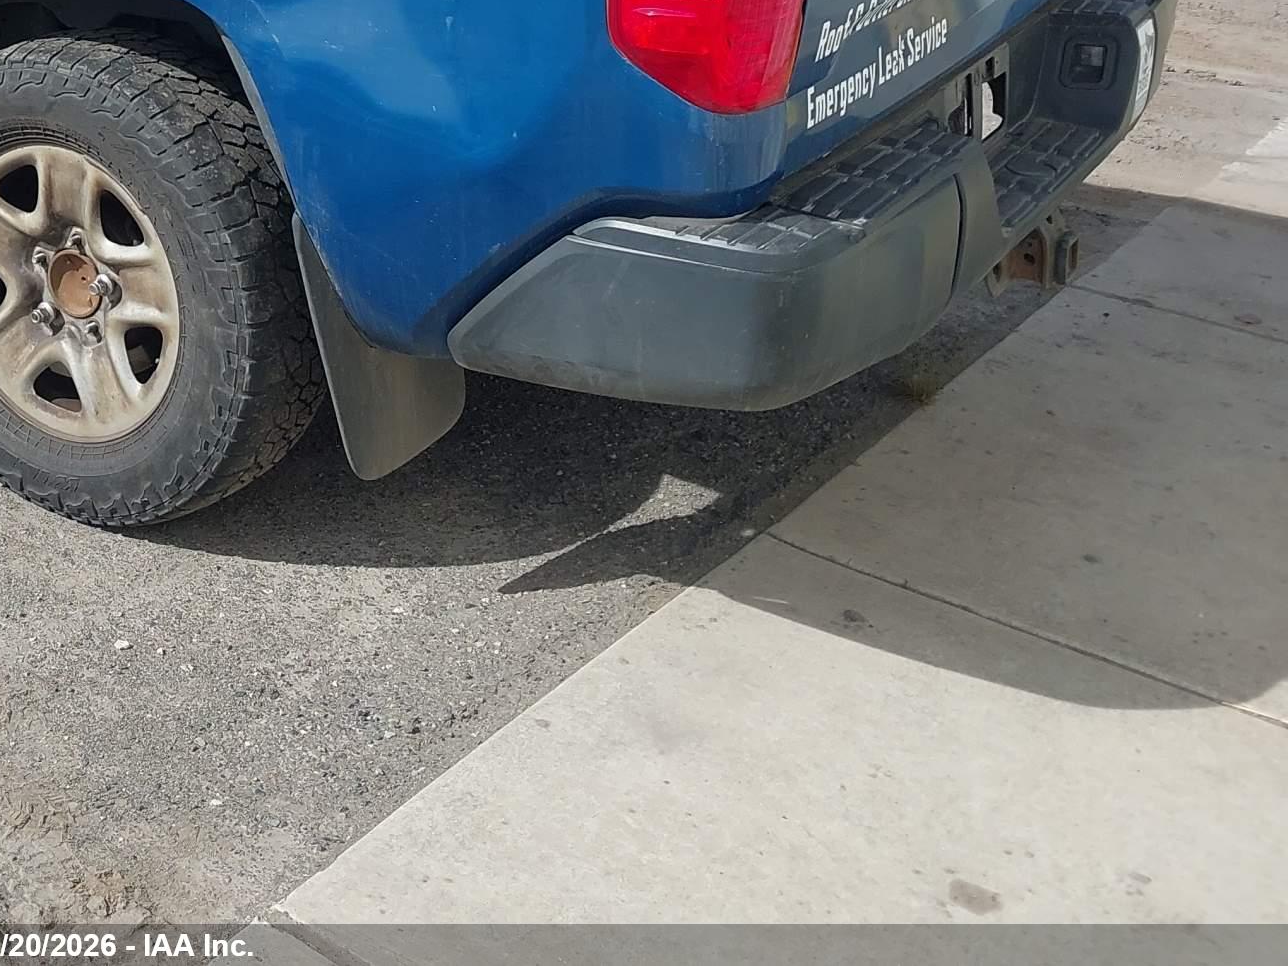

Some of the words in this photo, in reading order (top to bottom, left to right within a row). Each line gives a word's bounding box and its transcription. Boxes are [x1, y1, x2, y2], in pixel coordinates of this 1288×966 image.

[807, 64, 876, 128] Emergency
[879, 35, 904, 85] Leak
[907, 17, 947, 66] Service
